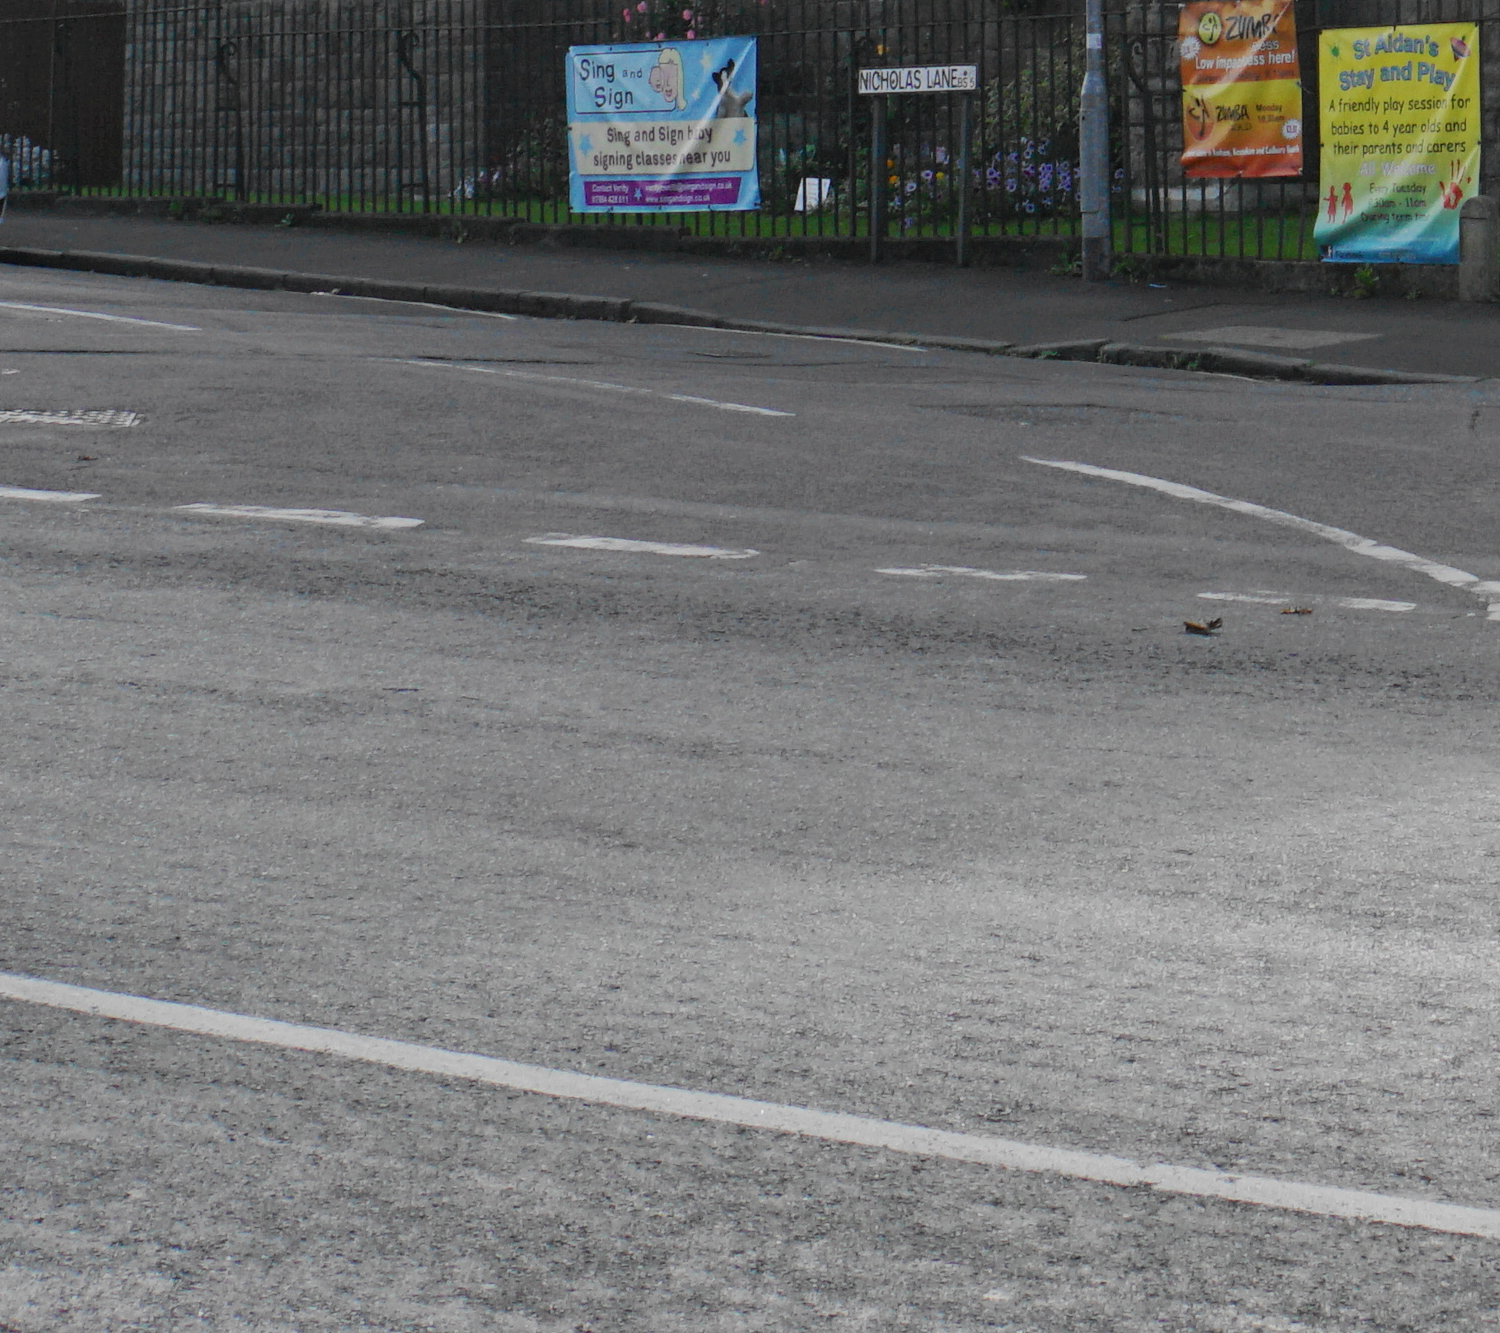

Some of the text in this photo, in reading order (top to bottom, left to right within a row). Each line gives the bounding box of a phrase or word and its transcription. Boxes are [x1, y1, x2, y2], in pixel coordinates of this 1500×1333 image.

[1353, 32, 1440, 60] St Aidan's
[1196, 49, 1296, 70] Low here!
[579, 59, 642, 83] Sing and
[860, 70, 921, 91] NICHOLAS
[926, 68, 958, 88] LANE
[1339, 60, 1457, 92] Stay and Play
[594, 87, 633, 109] Sign
[1328, 93, 1470, 116] A friendly play session for
[1216, 104, 1283, 122] ZUMBA Monday
[607, 127, 631, 147] Sing
[634, 126, 655, 142] and
[659, 126, 684, 146] Sign
[1331, 119, 1467, 138] babies to 4 year olds and
[1333, 139, 1466, 158] their parents and carers
[593, 153, 633, 170] signing
[711, 150, 731, 167] you
[1360, 161, 1436, 175] All Welcome
[592, 184, 612, 193] Contact
[1392, 182, 1427, 195] Tuesday
[1405, 197, 1427, 208] 11am
[1392, 212, 1413, 221] term
